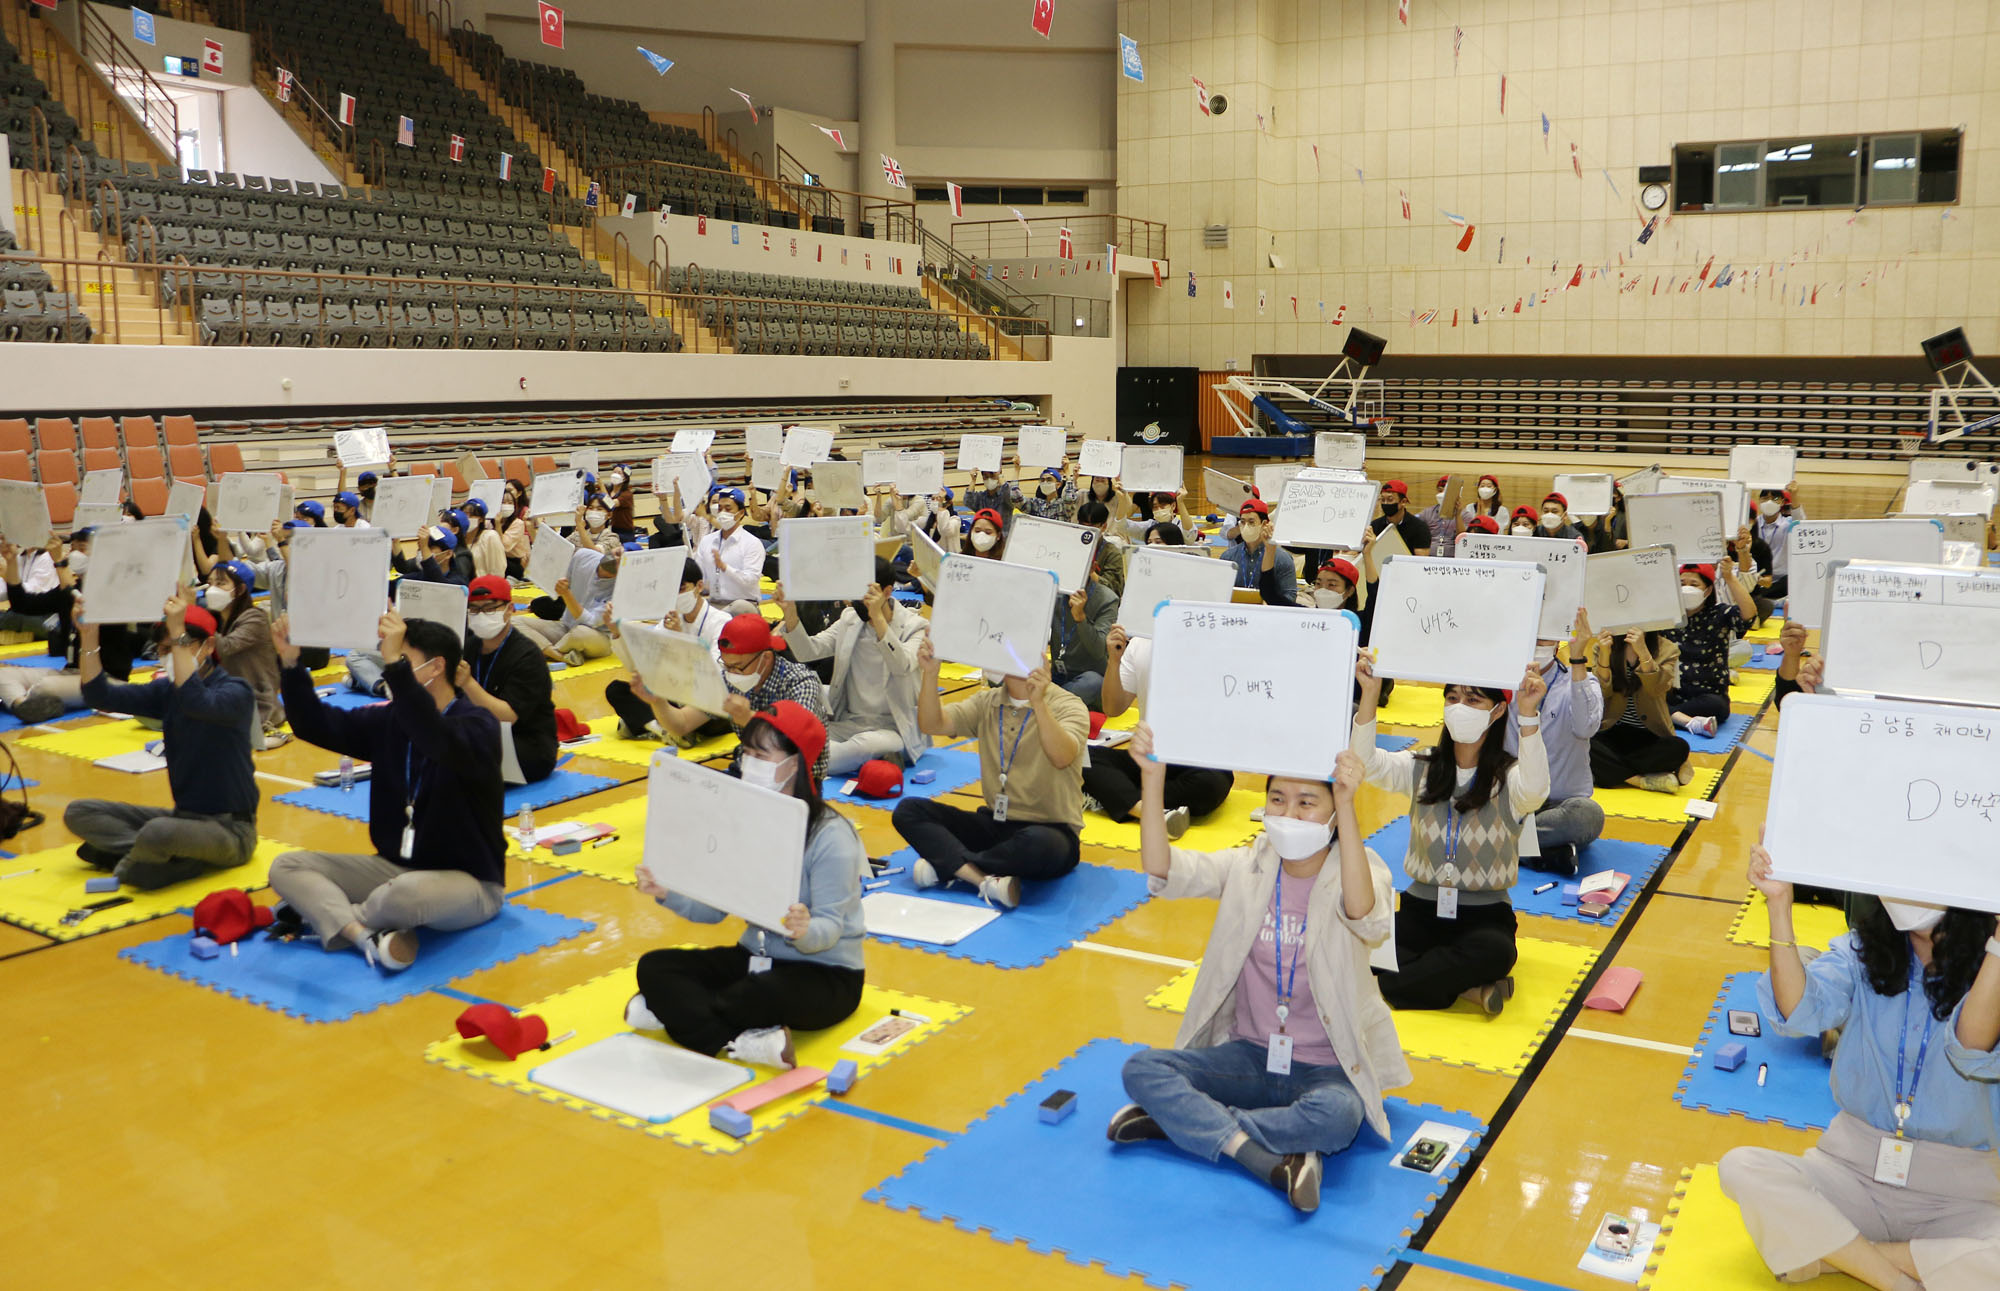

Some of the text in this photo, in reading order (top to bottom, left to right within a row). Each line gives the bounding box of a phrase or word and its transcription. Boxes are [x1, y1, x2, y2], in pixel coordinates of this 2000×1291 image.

[1615, 584, 1630, 604] D
[1183, 611, 1218, 629] 금남동
[1918, 640, 1943, 670] D
[1246, 679, 1275, 700] 배꽃
[1859, 712, 1916, 737] 금남동
[1906, 778, 1942, 822] D
